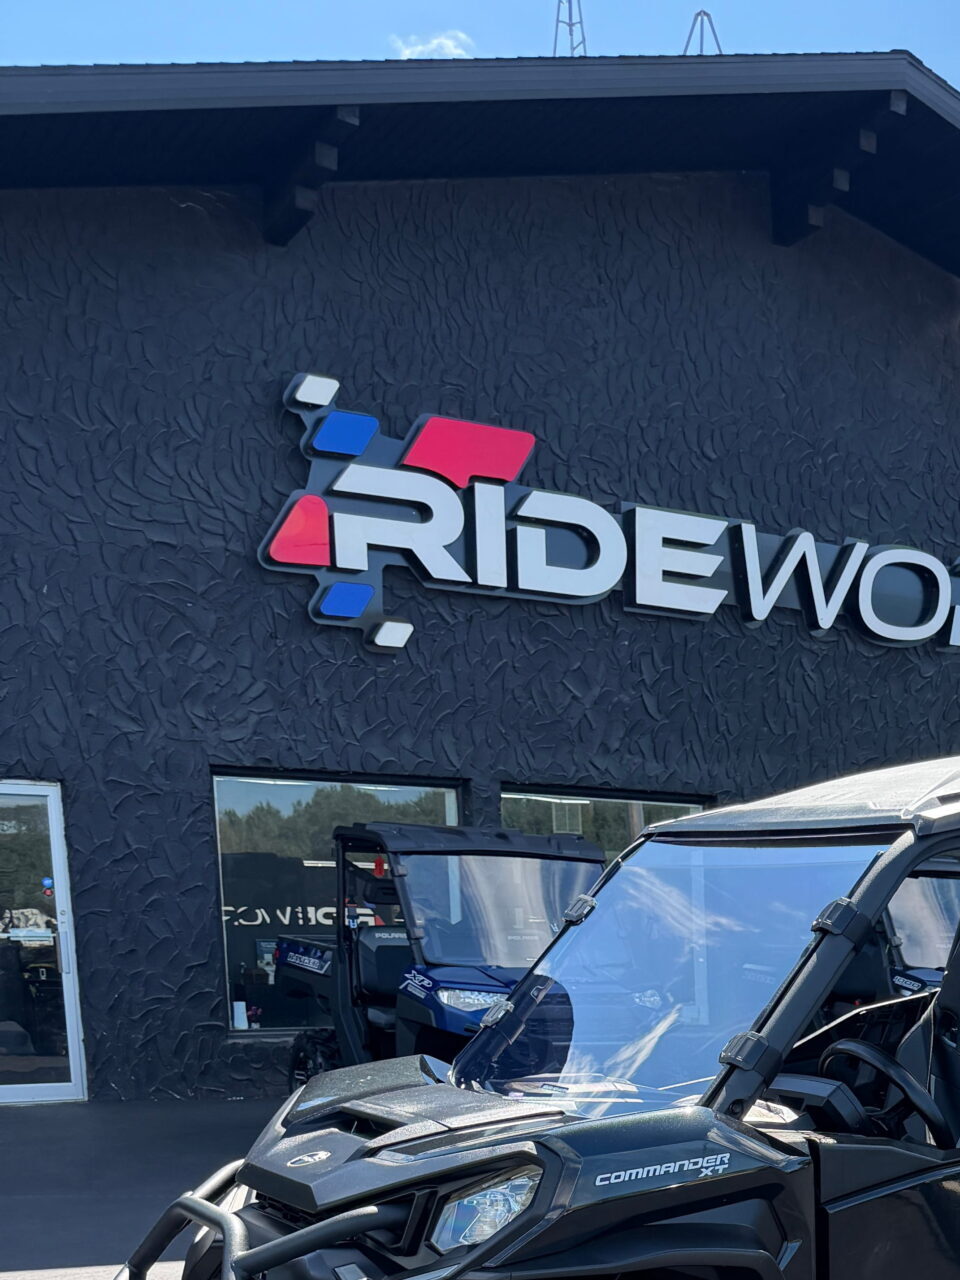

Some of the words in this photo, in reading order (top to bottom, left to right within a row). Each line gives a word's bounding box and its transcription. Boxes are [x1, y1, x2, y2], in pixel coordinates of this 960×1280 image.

[404, 970, 433, 988] XP
[595, 1153, 730, 1186] COMMANDER
[698, 1164, 729, 1178] XT
